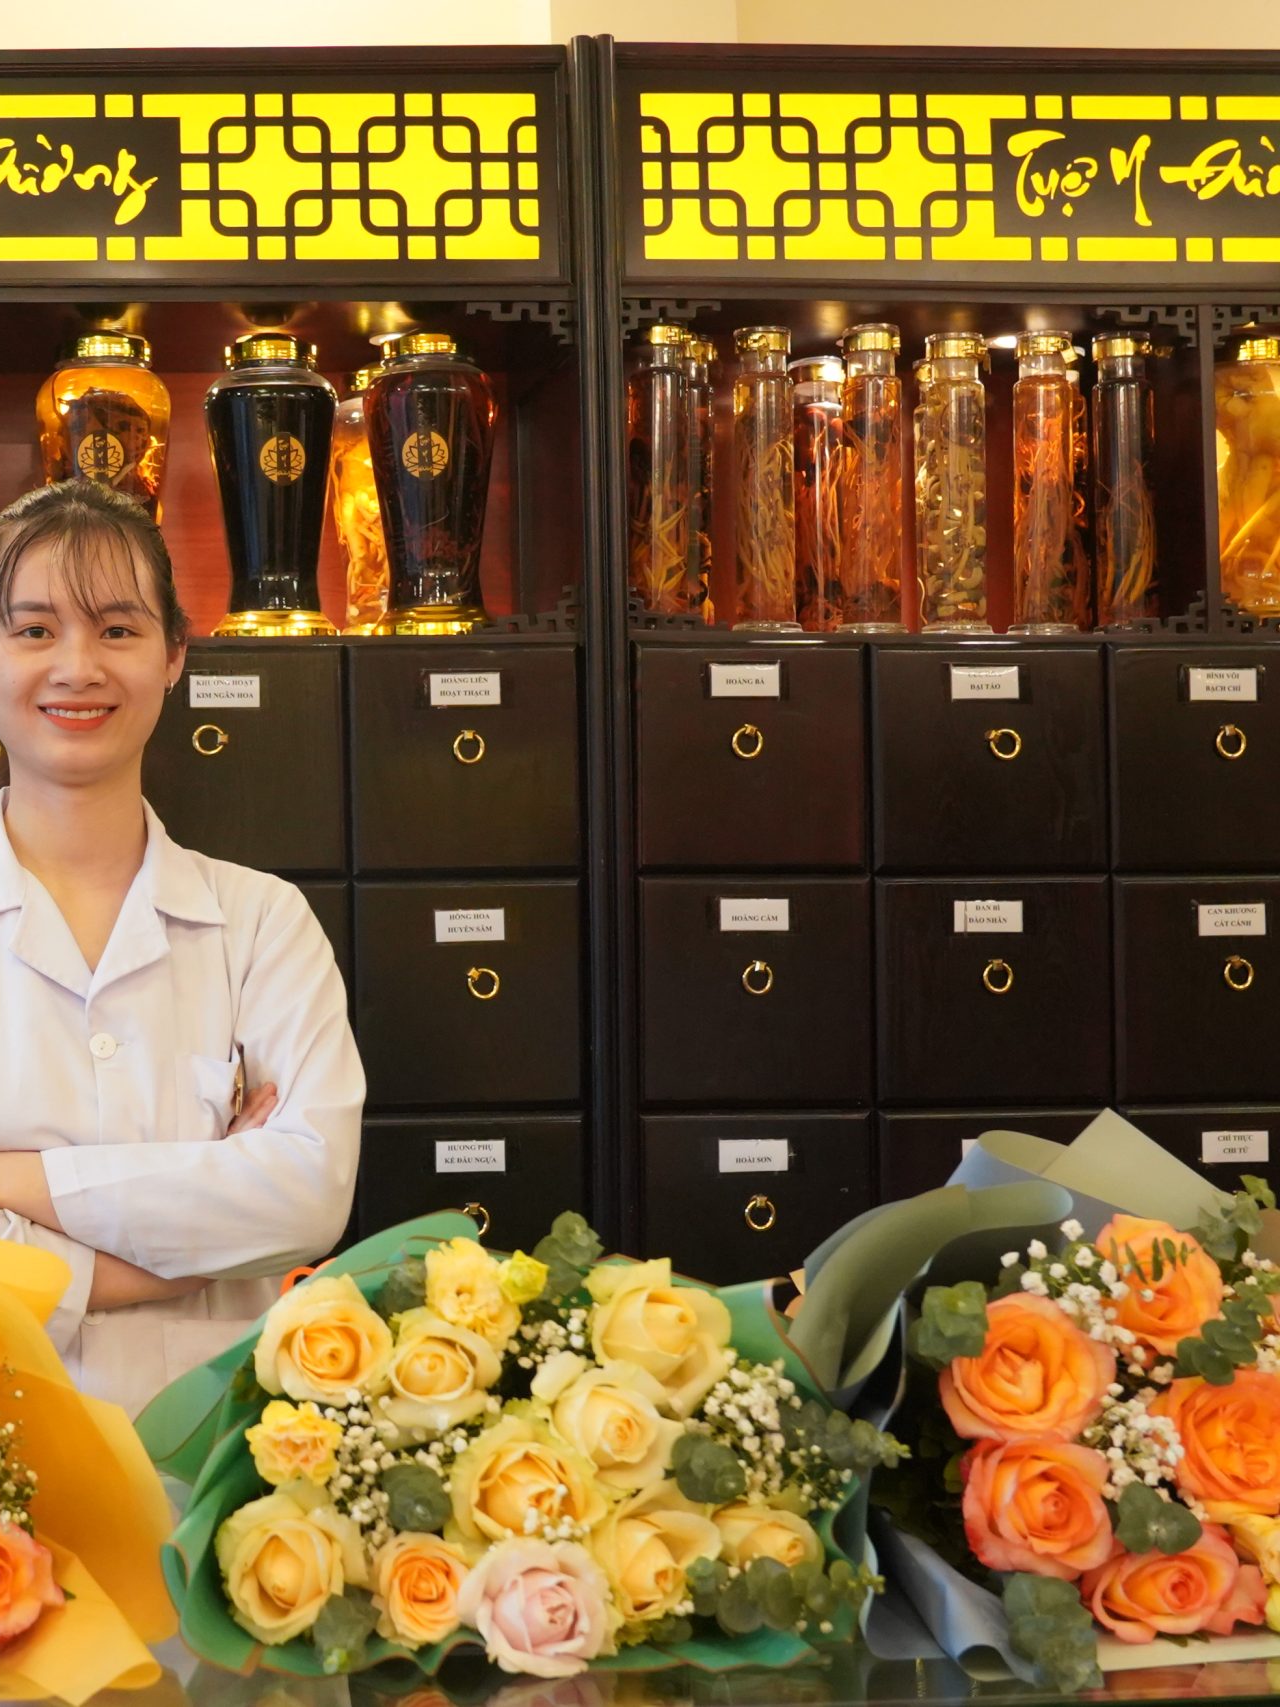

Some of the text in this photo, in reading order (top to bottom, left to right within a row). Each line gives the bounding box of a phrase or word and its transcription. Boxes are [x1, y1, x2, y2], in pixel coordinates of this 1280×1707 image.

[1007, 129, 1098, 218] Tuệ
[441, 676, 488, 684] HOÀNG LIÊN
[726, 677, 753, 685] HOÀNG
[985, 682, 1001, 691] TÁO
[1205, 684, 1226, 693] BẠCH
[196, 691, 254, 699] KIM NGÂN HOA
[440, 689, 490, 697] HOẠT THẠCH
[1207, 907, 1257, 915] CAN KHƯƠNG
[473, 912, 490, 921] HOA
[731, 914, 759, 922] HOÀNG
[986, 916, 1007, 924] NHÂN
[1230, 919, 1251, 928] CÁNH
[476, 925, 492, 934] SÂM
[447, 1143, 494, 1152] HƯƠNG PHỤ
[474, 1156, 497, 1165] NGỰA
[736, 1155, 772, 1164] HOÀI SƠN
